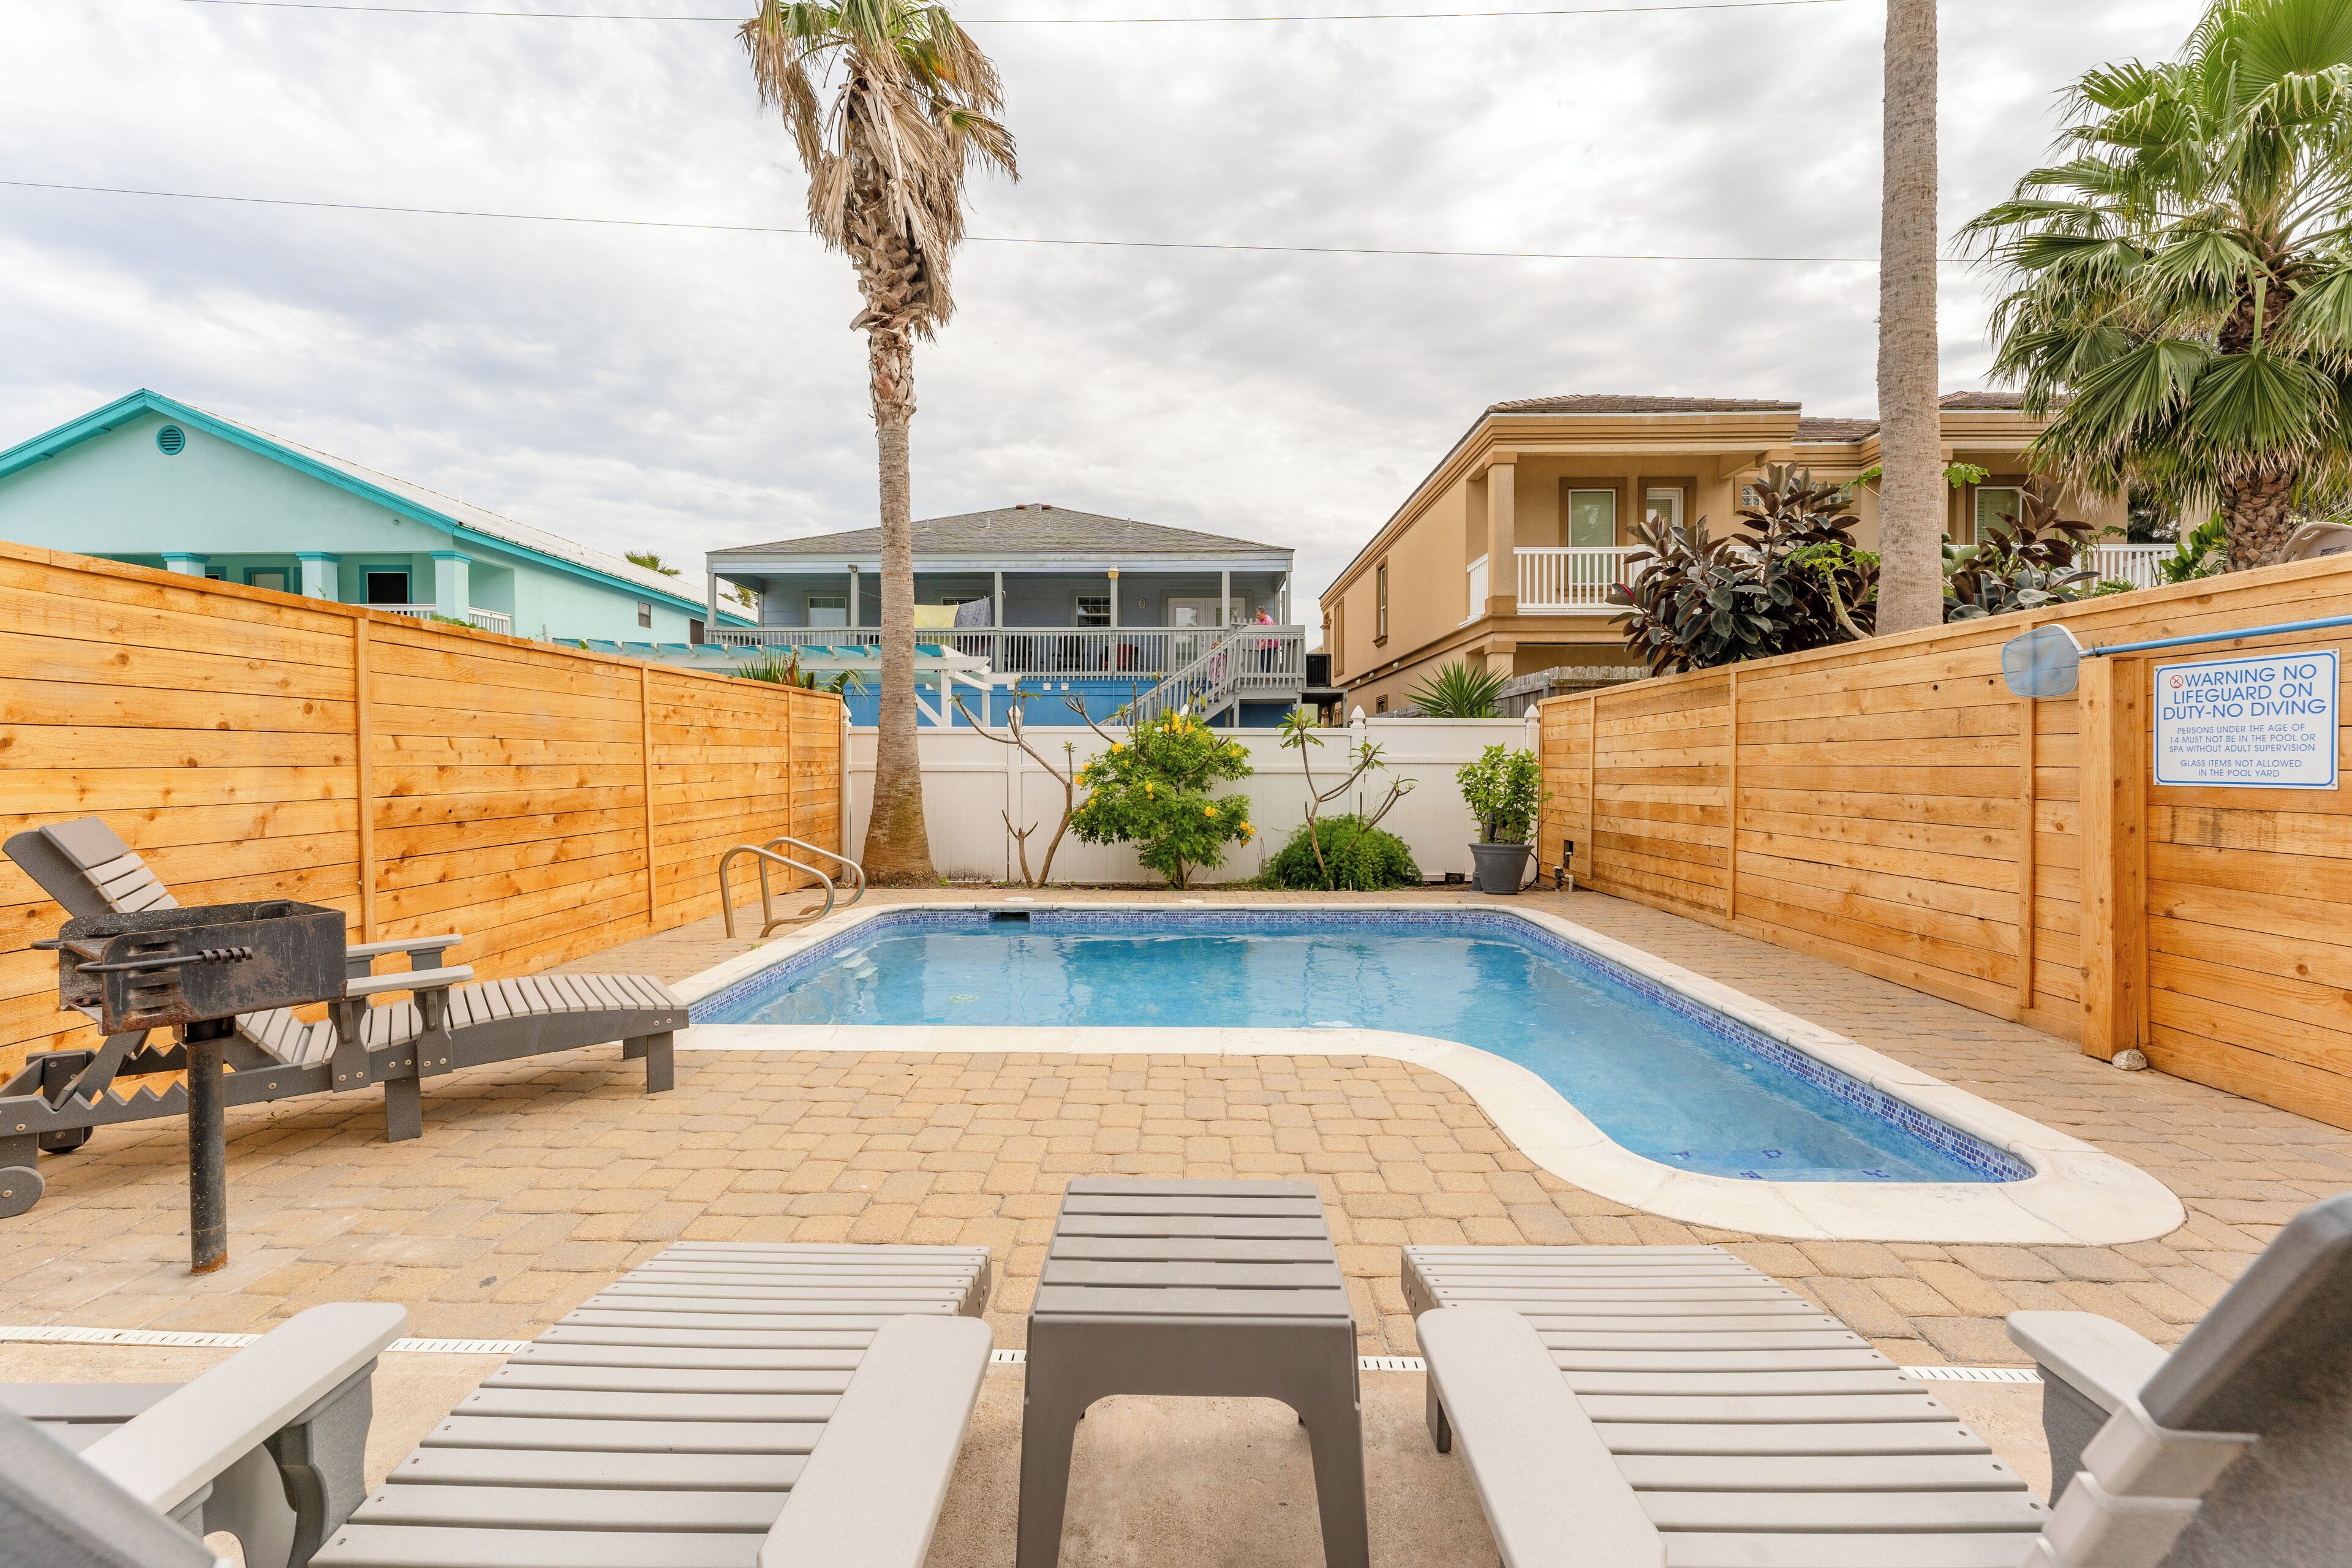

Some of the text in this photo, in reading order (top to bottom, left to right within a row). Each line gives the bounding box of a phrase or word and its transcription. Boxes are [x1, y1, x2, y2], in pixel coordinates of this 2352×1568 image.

[2185, 664, 2316, 687] WARNING NO
[2174, 682, 2312, 704] LIFEGUARD ON
[2164, 699, 2326, 720] DUTY-NO DIVING
